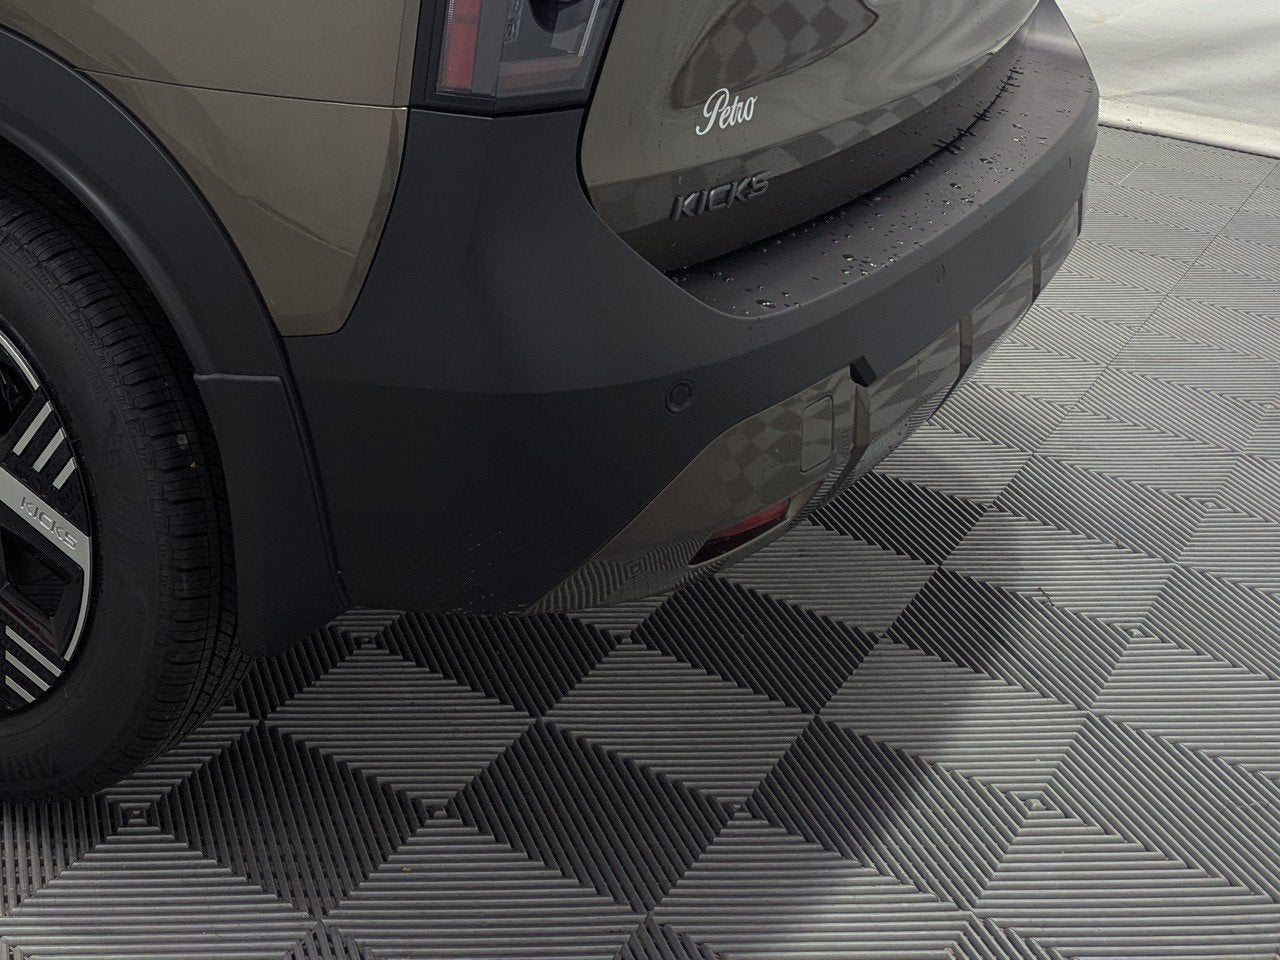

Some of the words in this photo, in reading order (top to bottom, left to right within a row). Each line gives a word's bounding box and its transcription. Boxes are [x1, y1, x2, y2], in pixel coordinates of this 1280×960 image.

[695, 87, 758, 135] Petro
[671, 170, 771, 221] KICKS
[21, 496, 78, 551] KICKS
